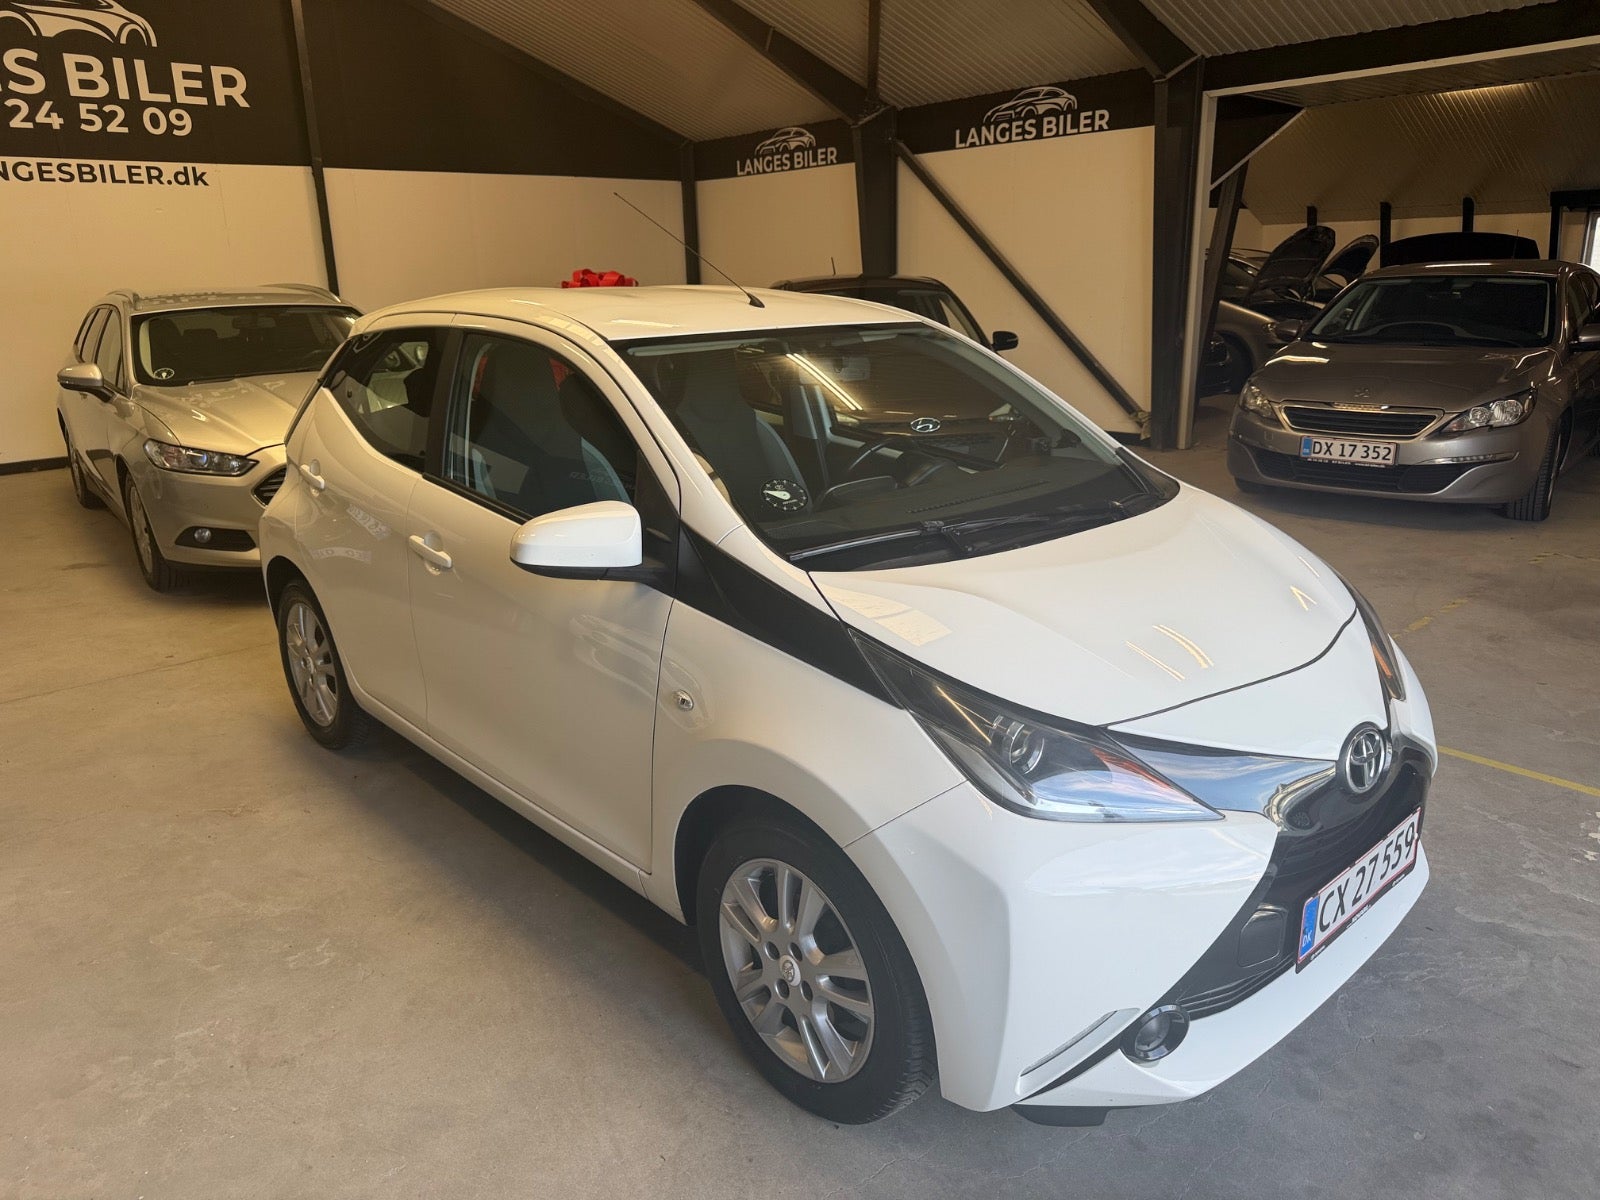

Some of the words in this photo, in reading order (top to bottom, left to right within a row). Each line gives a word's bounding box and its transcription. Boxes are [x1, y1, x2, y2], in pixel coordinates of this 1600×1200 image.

[0, 48, 46, 95] S
[62, 53, 250, 108] BILER
[4, 98, 64, 130] 24
[79, 103, 129, 133] 52
[142, 107, 192, 136] 09
[955, 119, 1037, 148] LANGES
[1042, 109, 1110, 138] BILER
[736, 153, 791, 176] LANGES
[793, 147, 838, 169] BILER
[1312, 441, 1334, 456] DX
[1338, 443, 1358, 458] 17
[1360, 445, 1391, 461] 352
[1319, 877, 1350, 933] CX
[1351, 852, 1379, 907] 27
[1380, 821, 1415, 881] 559
